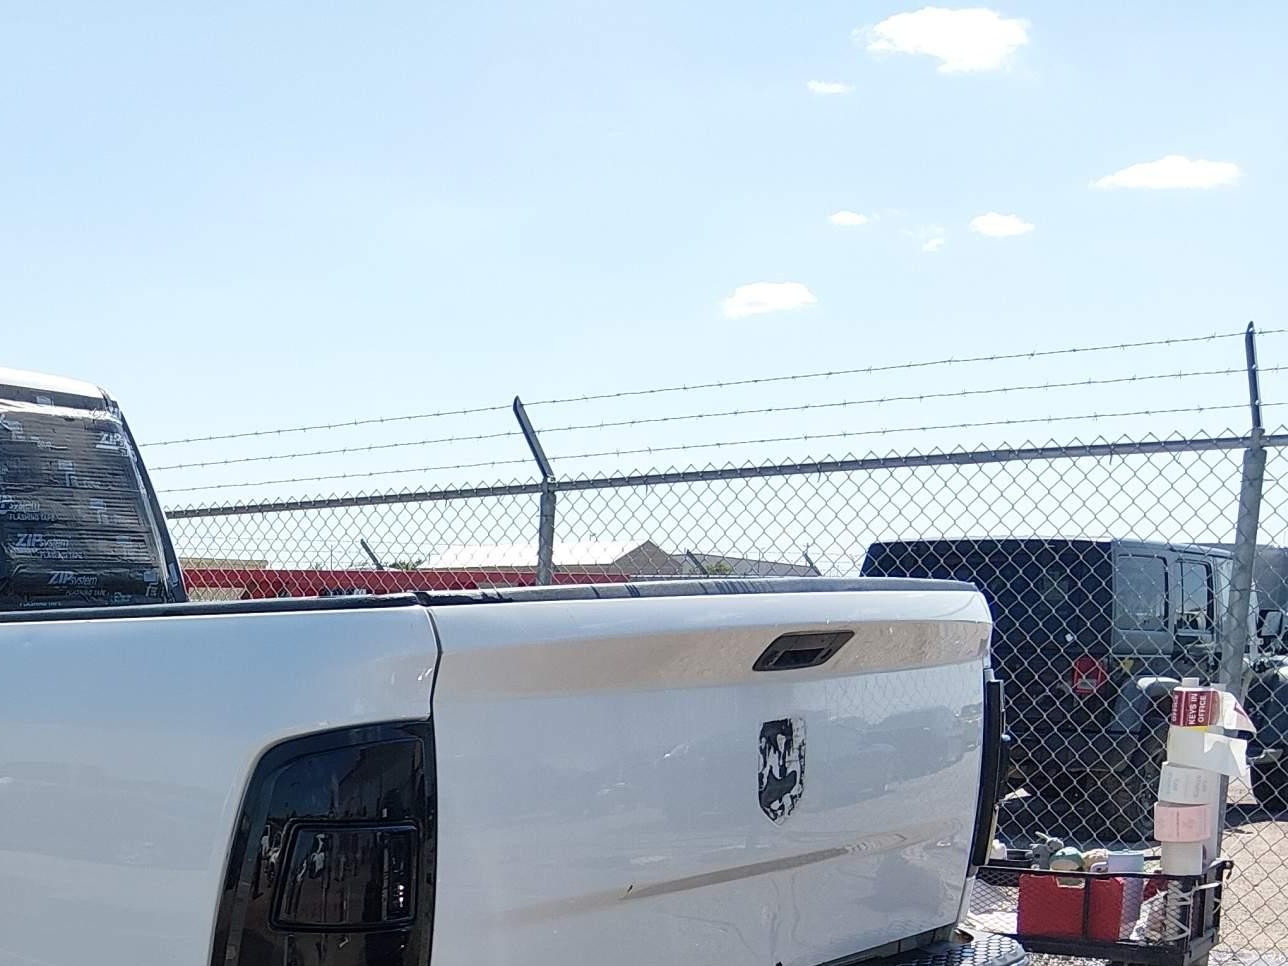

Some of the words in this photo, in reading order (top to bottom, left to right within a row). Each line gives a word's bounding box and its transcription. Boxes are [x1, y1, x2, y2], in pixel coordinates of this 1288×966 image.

[1191, 693, 1199, 702] IN
[1188, 704, 1197, 725] KEYS
[1198, 695, 1207, 723] OFFICE
